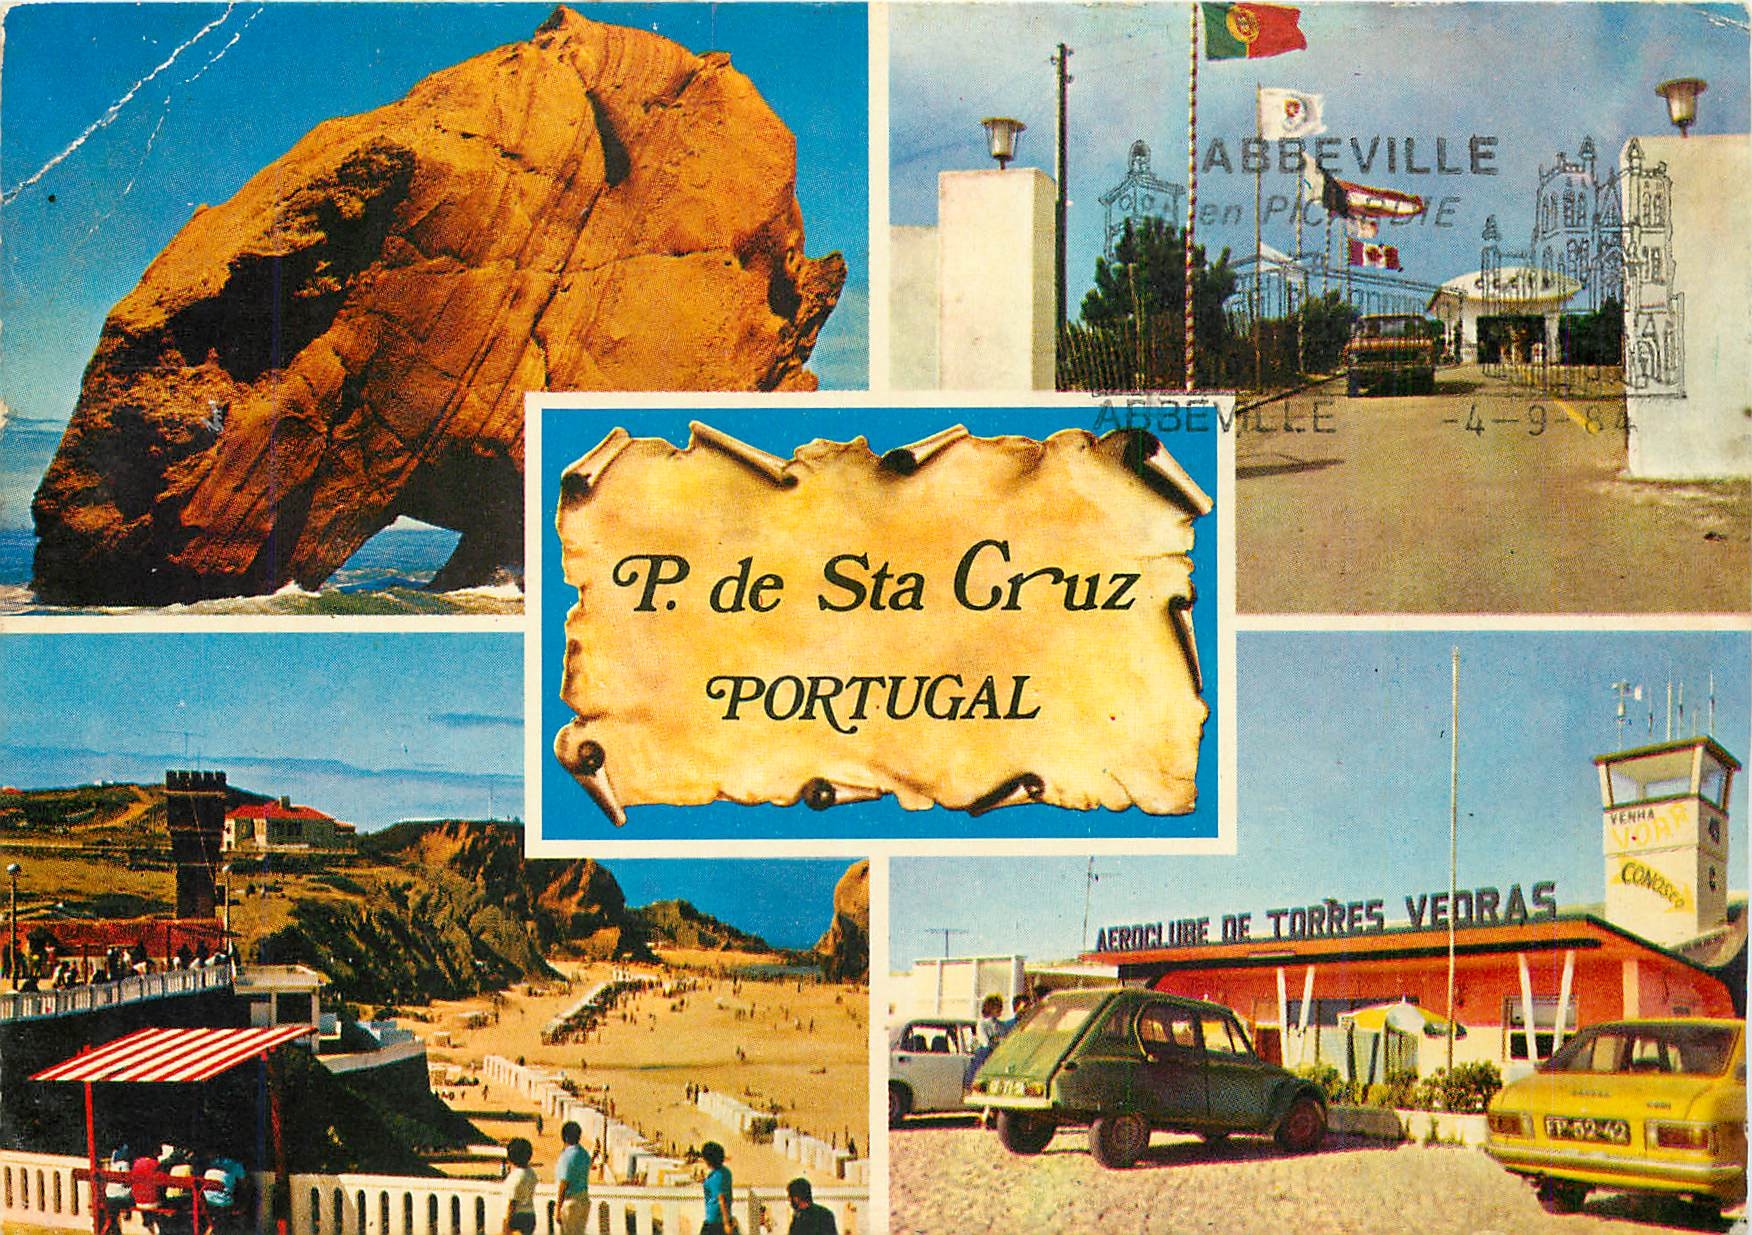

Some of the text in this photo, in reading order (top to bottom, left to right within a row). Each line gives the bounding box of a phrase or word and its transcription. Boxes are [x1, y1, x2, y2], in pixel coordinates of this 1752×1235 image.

[1610, 808, 1655, 824] VENHA
[1610, 802, 1688, 849] VOAR
[1097, 881, 1556, 952] AEROCLUBE DE TORRES VEDRAS
